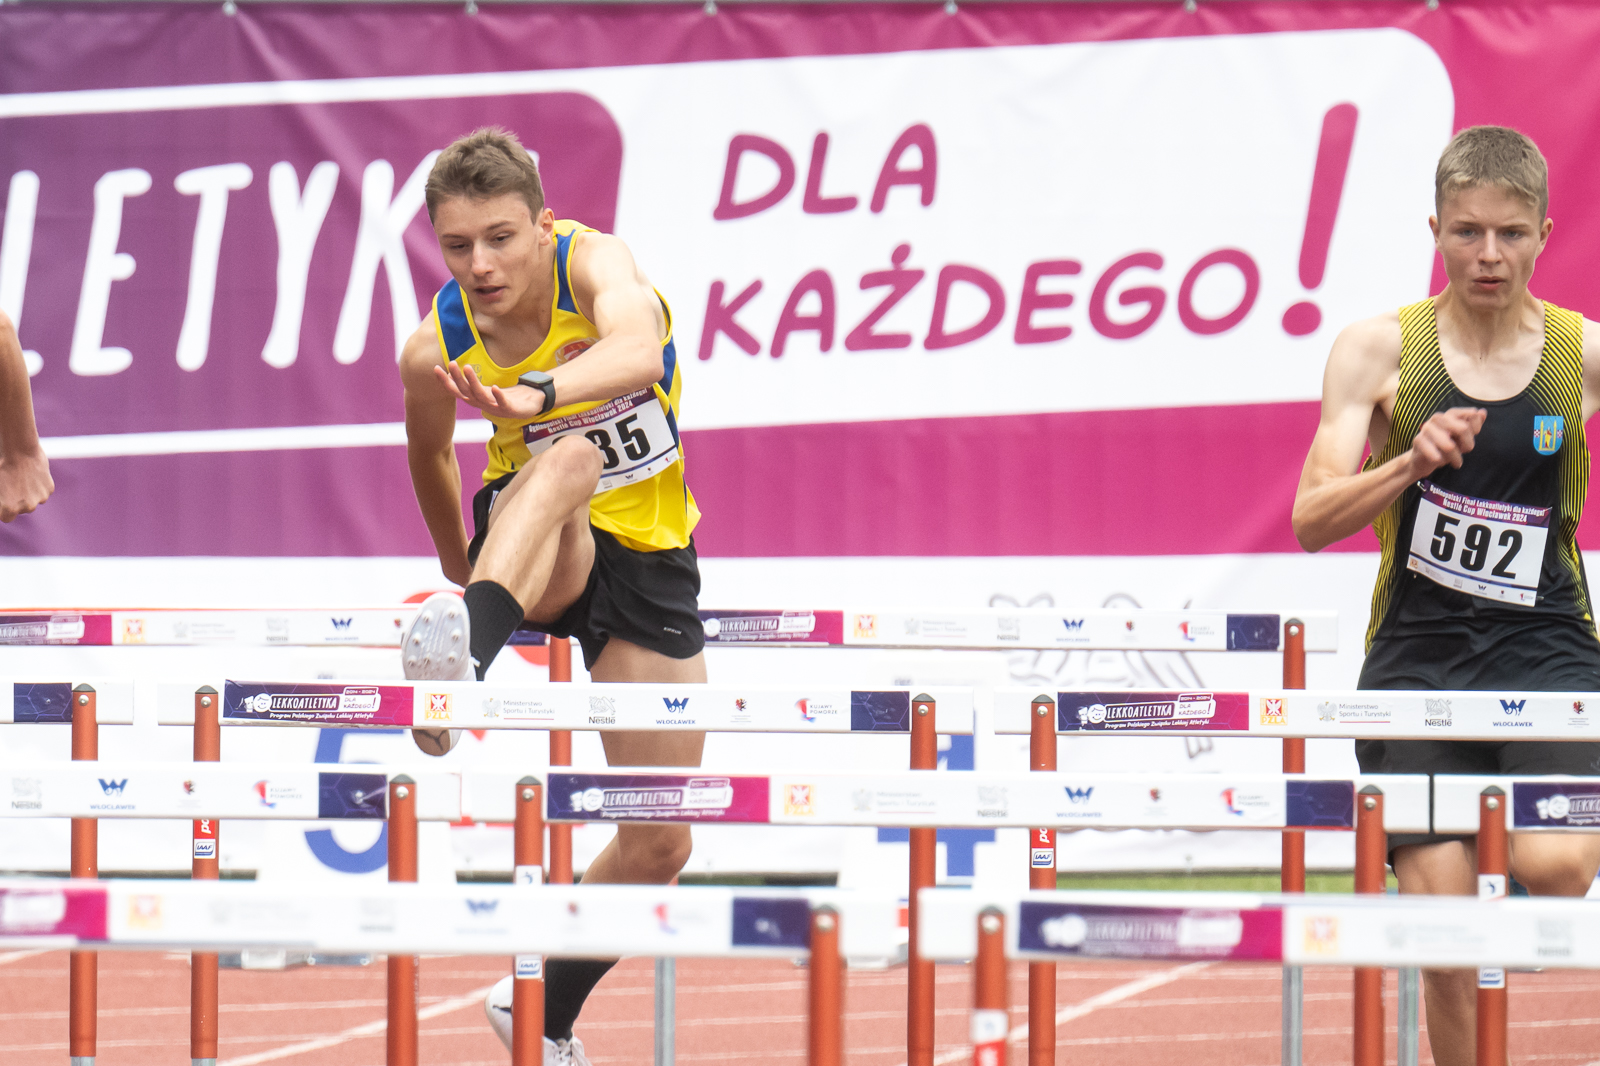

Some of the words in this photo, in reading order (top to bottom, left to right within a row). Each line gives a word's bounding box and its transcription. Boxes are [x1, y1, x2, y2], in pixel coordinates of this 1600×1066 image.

[713, 122, 938, 221] DLA
[569, 419, 582, 428] Cup
[618, 400, 634, 412] 2024
[552, 413, 651, 470] 35
[1463, 504, 1476, 515] Cup
[1512, 513, 1527, 523] 2024
[1429, 512, 1524, 580] 592
[271, 694, 338, 710] LEKKOATLETYKA
[270, 712, 291, 720] Program
[291, 712, 315, 720] Polskiego
[335, 712, 353, 720] Lekkiej
[353, 712, 375, 720] Atletyki
[425, 711, 451, 720] PZLA
[503, 707, 523, 715] Sportu
[528, 707, 555, 715] Turystyki
[1106, 703, 1172, 720] LEKKOATLETYKA
[1339, 710, 1359, 718] Sportu
[1364, 710, 1392, 718] Turystyki
[1105, 722, 1127, 730] Program
[1127, 721, 1151, 729] Polskiego
[1150, 720, 1171, 728] Związku
[1171, 719, 1189, 728] Lekkiej
[1189, 718, 1210, 726] Atletyki
[1260, 715, 1286, 725] PZLA
[603, 790, 681, 807] LEKKOATLETYKA
